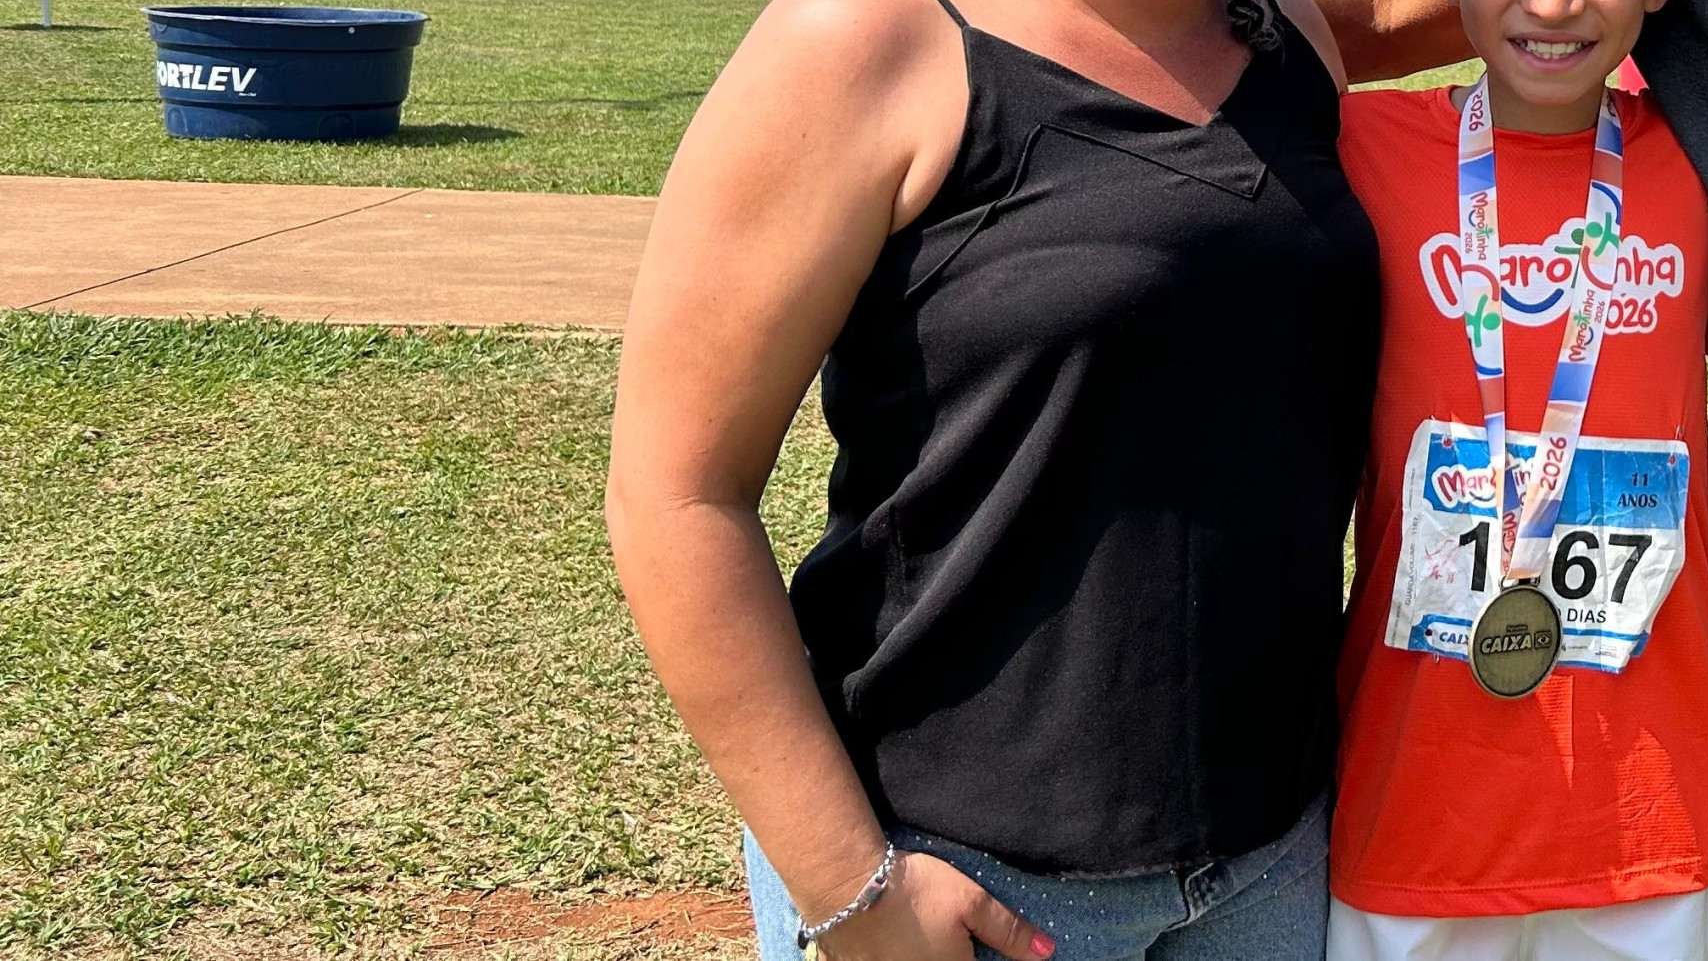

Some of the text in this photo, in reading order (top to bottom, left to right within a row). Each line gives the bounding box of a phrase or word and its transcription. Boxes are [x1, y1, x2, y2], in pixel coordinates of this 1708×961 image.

[156, 60, 257, 92] ORTLEV
[1468, 90, 1485, 132] 2026
[1606, 298, 1654, 329] 026
[1540, 436, 1567, 491] 2026
[1631, 471, 1649, 487] 11
[1617, 492, 1659, 509] ANOS
[1459, 520, 1653, 604] 167
[1567, 608, 1607, 624] DIAS
[1481, 633, 1533, 655] CAIXA
